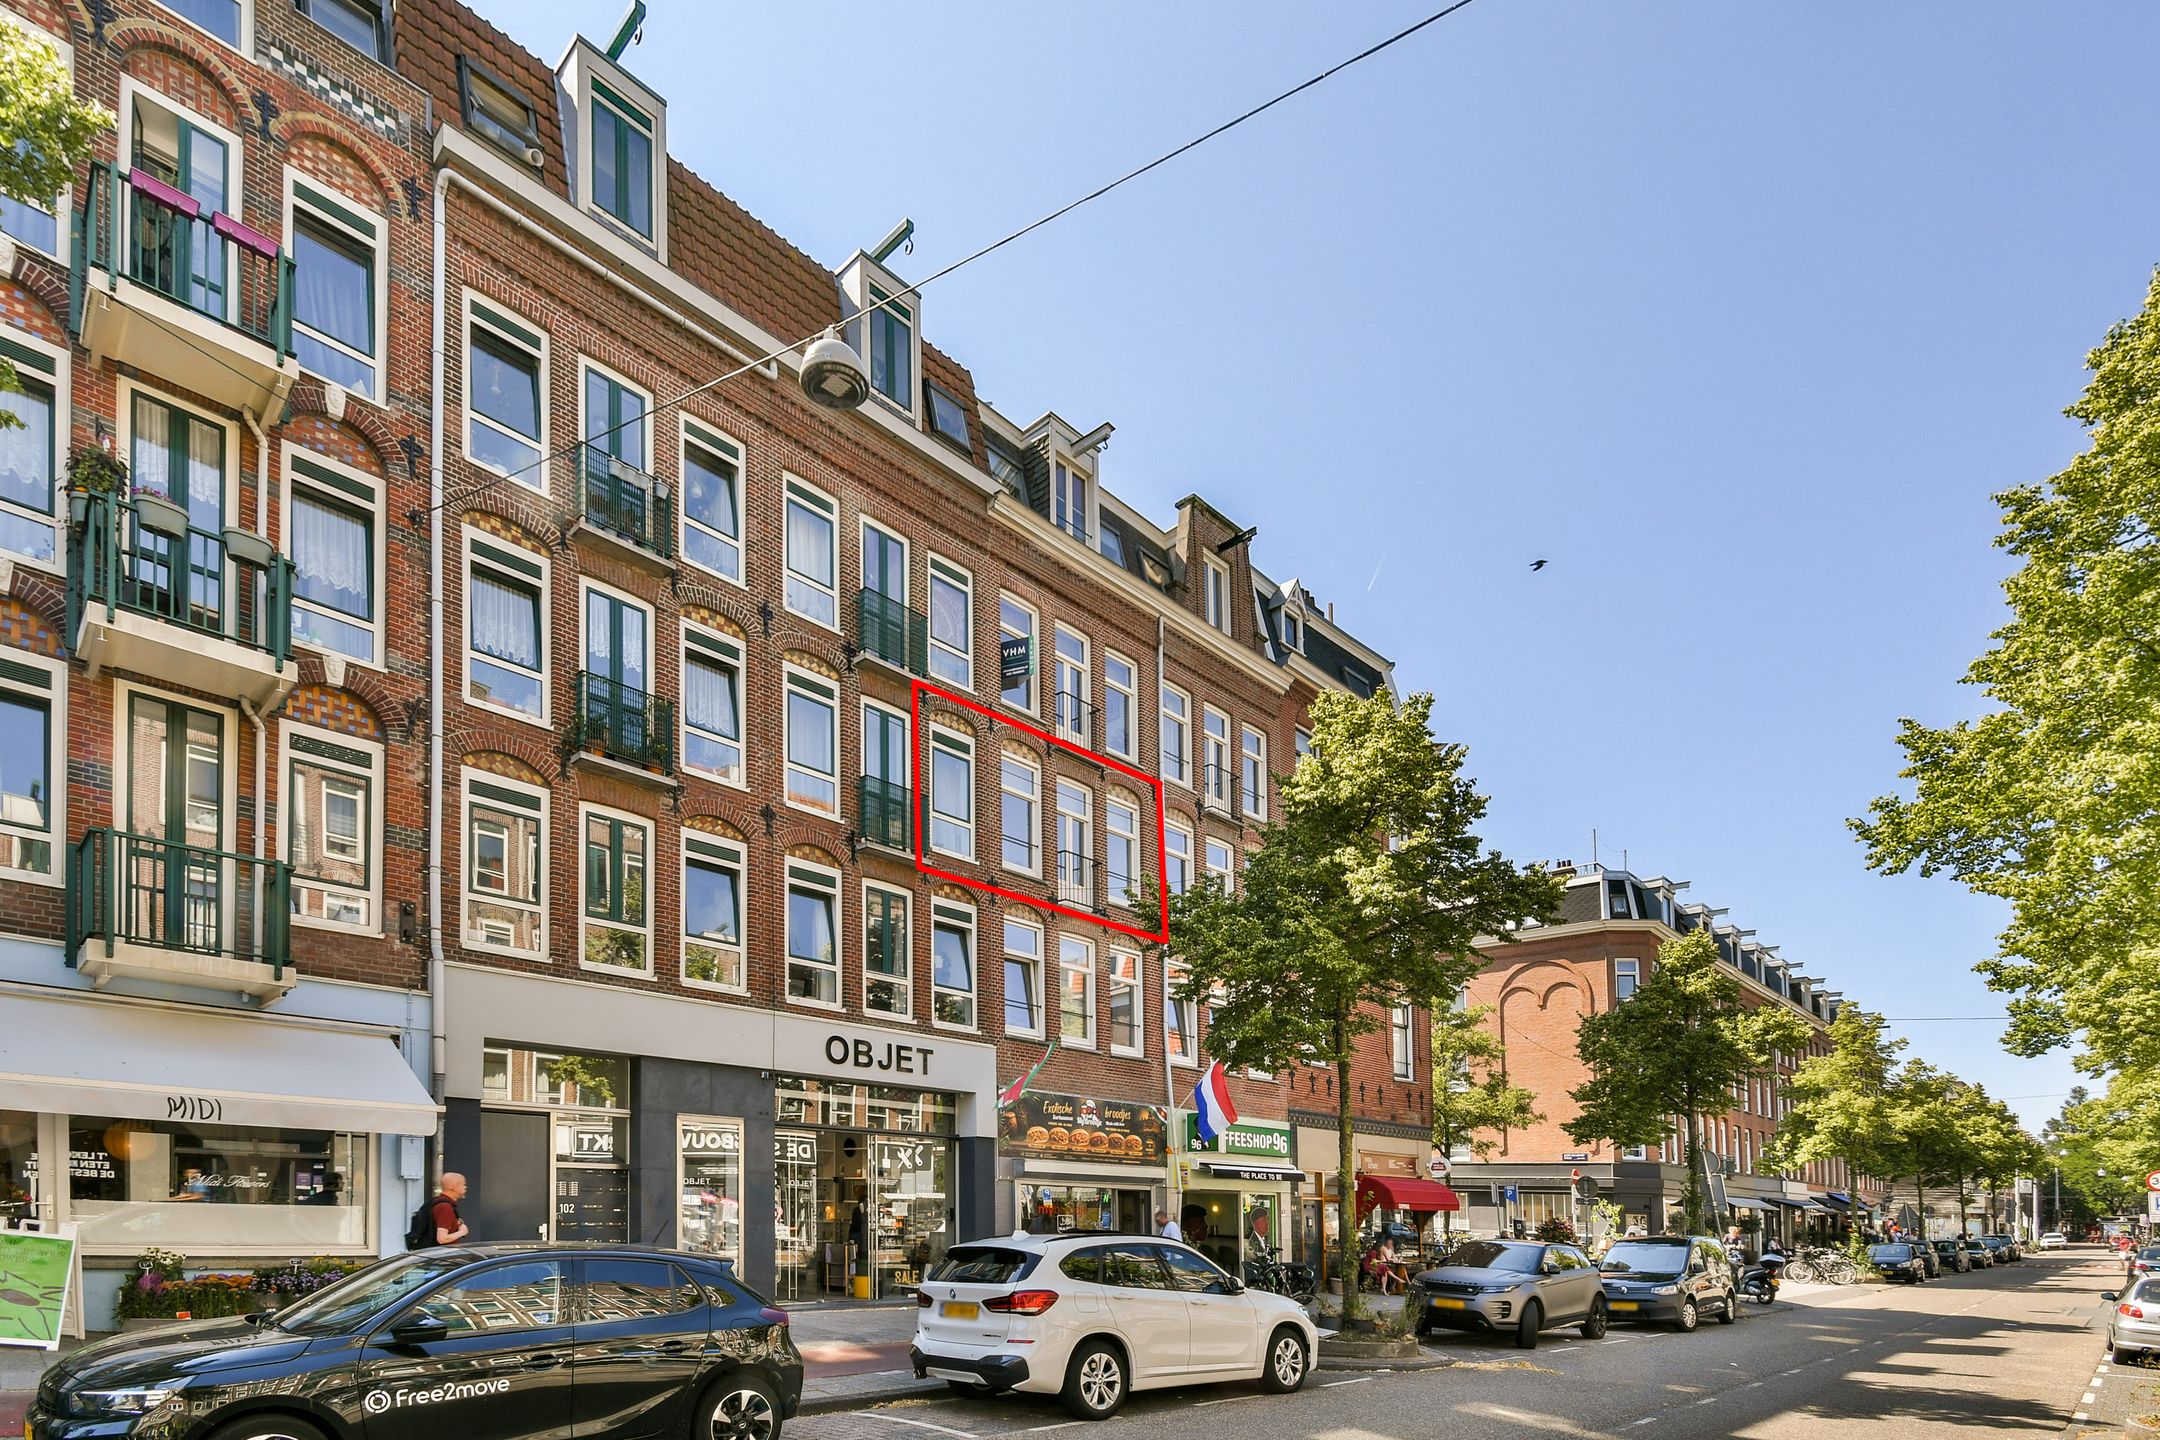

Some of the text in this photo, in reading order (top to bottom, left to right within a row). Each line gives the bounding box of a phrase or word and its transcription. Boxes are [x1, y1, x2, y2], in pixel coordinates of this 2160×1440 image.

[1002, 645, 1026, 657] VHM
[825, 1035, 934, 1075] OBJET
[167, 1096, 222, 1121] MIDI
[1043, 1100, 1073, 1114] Exotische
[1104, 1106, 1131, 1122] broodjes
[1191, 1138, 1202, 1150] 96
[184, 1173, 272, 1188] Midi Flowers
[1240, 1171, 1250, 1179] THE
[1251, 1172, 1267, 1180] PLACE
[1276, 1173, 1282, 1181] BE
[1507, 1190, 1513, 1198] P
[559, 1203, 575, 1213] 102
[895, 1270, 919, 1283] SALE
[395, 1379, 511, 1408] Free2move
